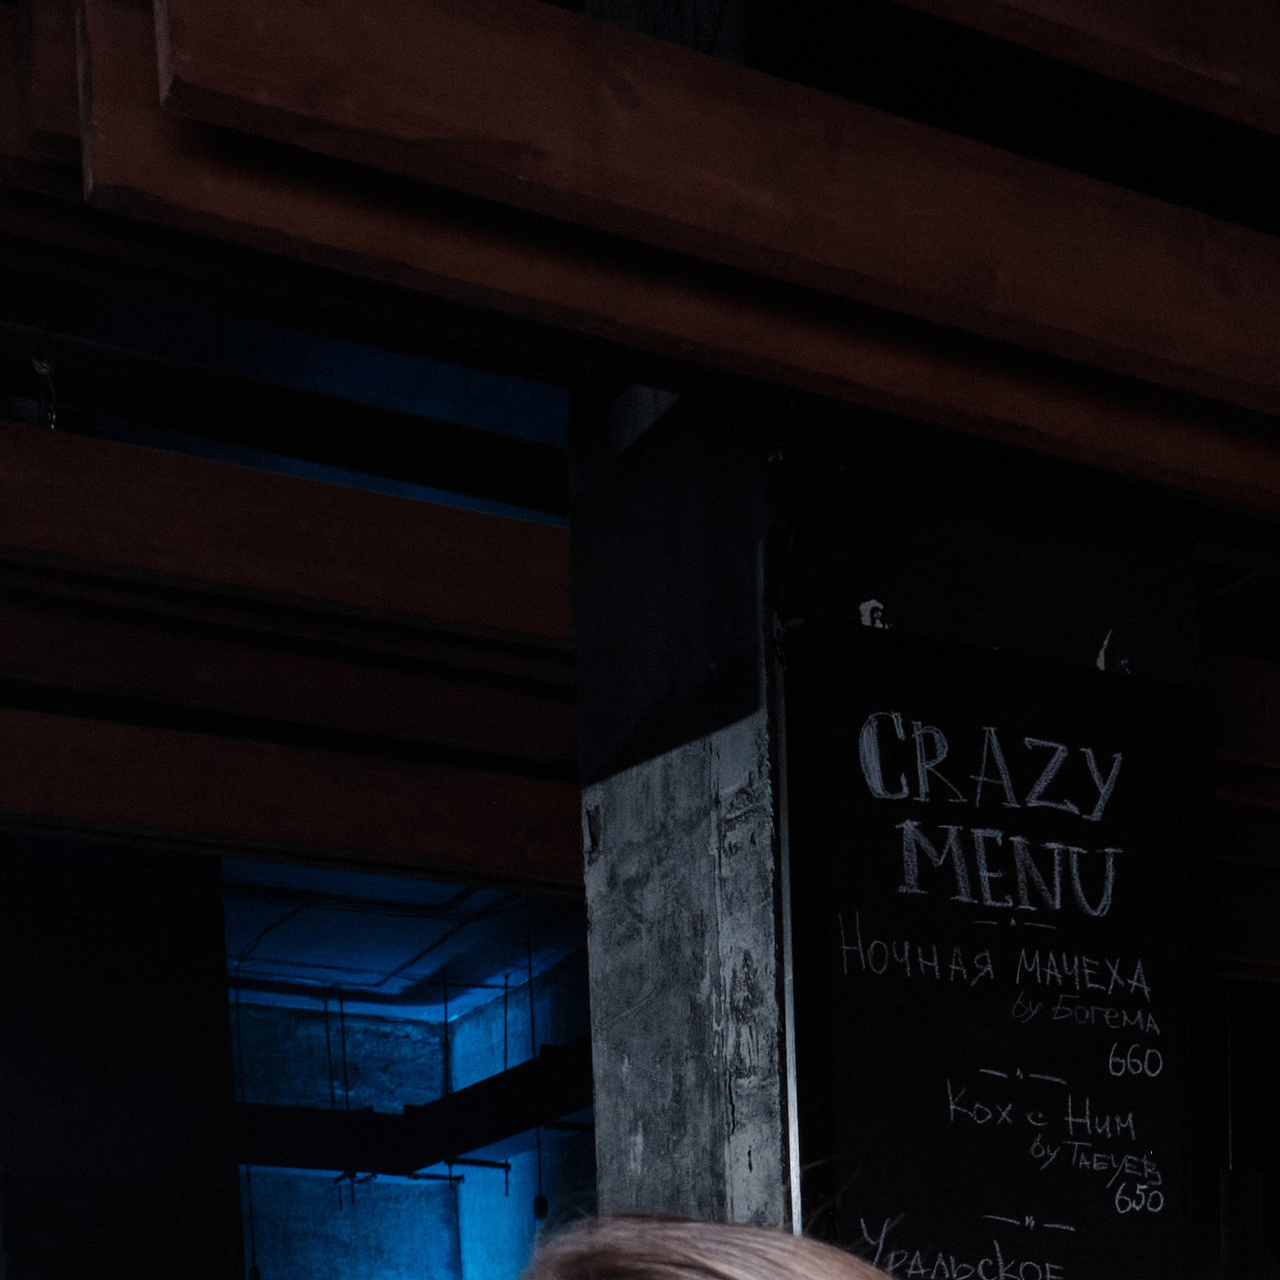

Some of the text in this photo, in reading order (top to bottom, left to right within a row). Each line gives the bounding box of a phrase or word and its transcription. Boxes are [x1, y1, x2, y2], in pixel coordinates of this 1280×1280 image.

[858, 711, 1123, 821] CRAZY
[895, 819, 1124, 917] MENU
[838, 909, 1151, 1003] НОЧНАЯ МАЧЕХА
[1108, 1042, 1163, 1078] 660
[1114, 1182, 1165, 1214] 650
